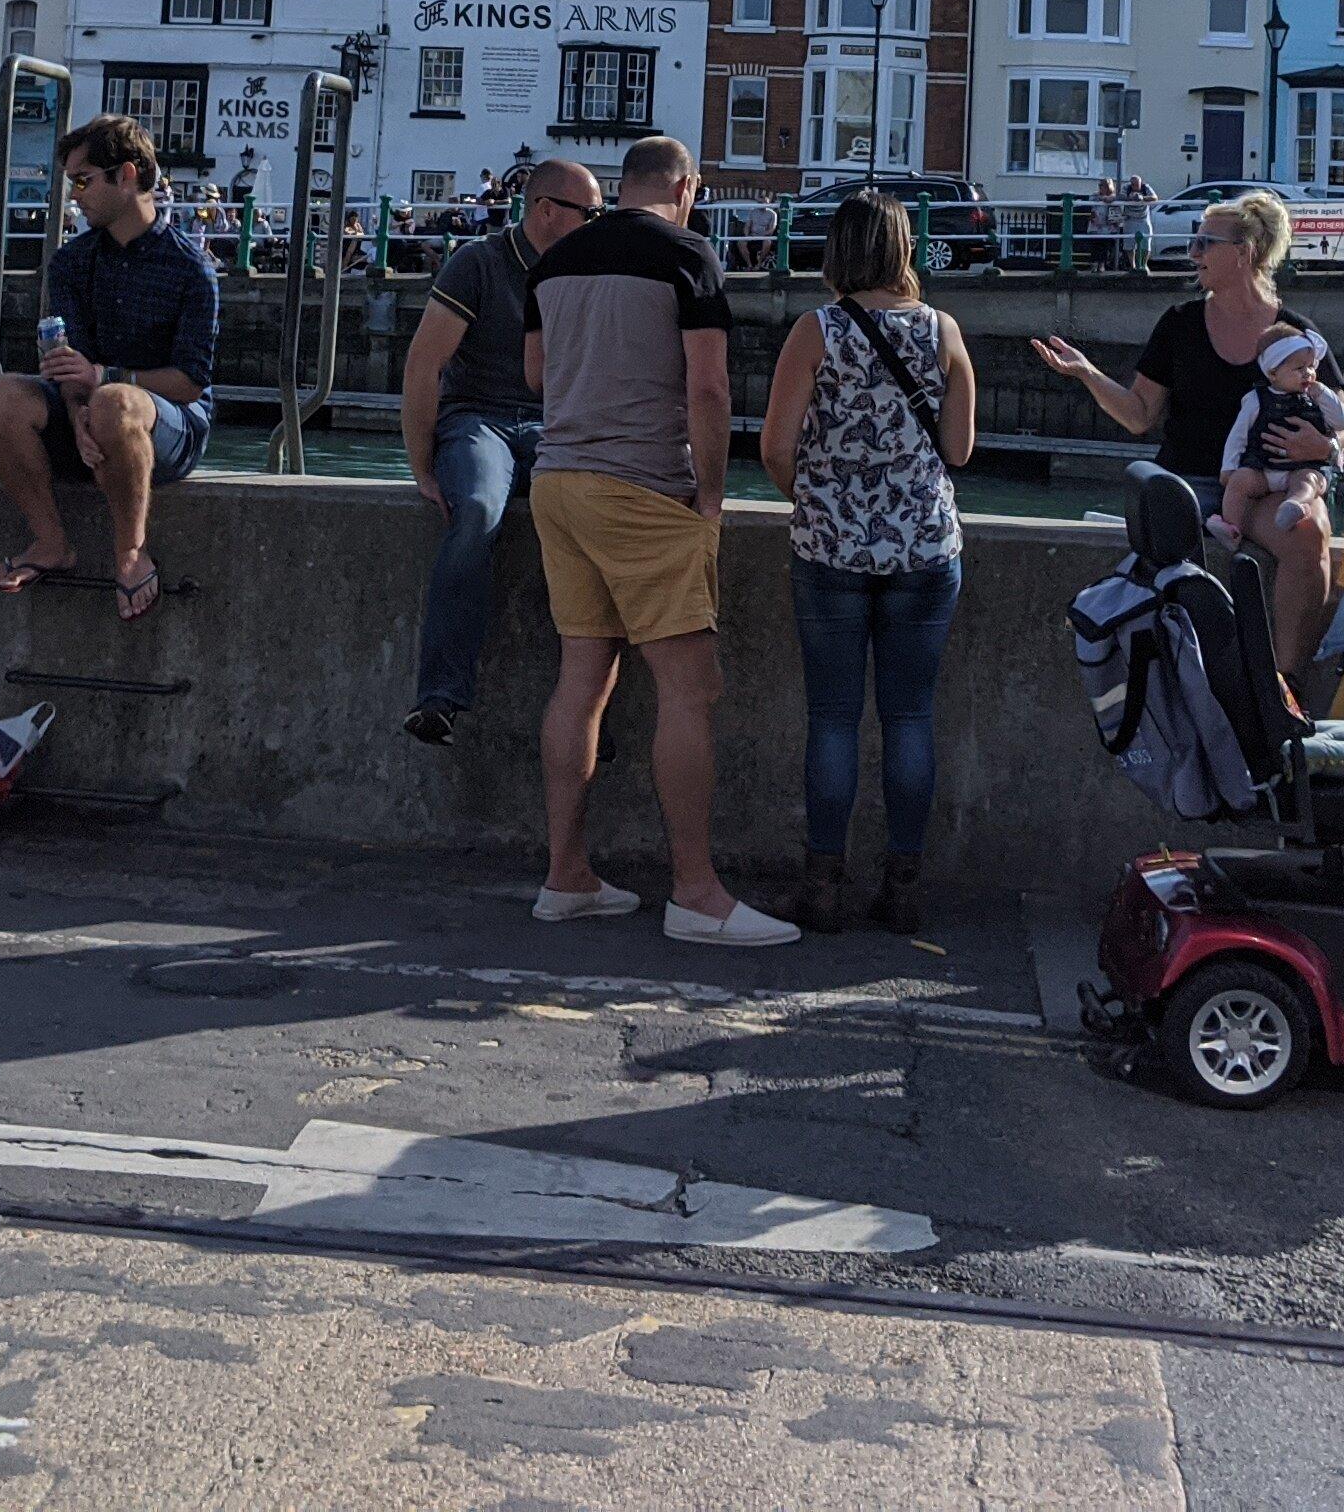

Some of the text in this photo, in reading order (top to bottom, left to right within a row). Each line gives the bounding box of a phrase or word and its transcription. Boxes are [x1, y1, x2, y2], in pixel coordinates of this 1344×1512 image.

[413, 0, 677, 33] THE KINGS ARMS
[218, 97, 290, 118] KINGS
[217, 120, 290, 139] ARMS
[1320, 208, 1343, 217] apart
[1301, 221, 1316, 229] AND
